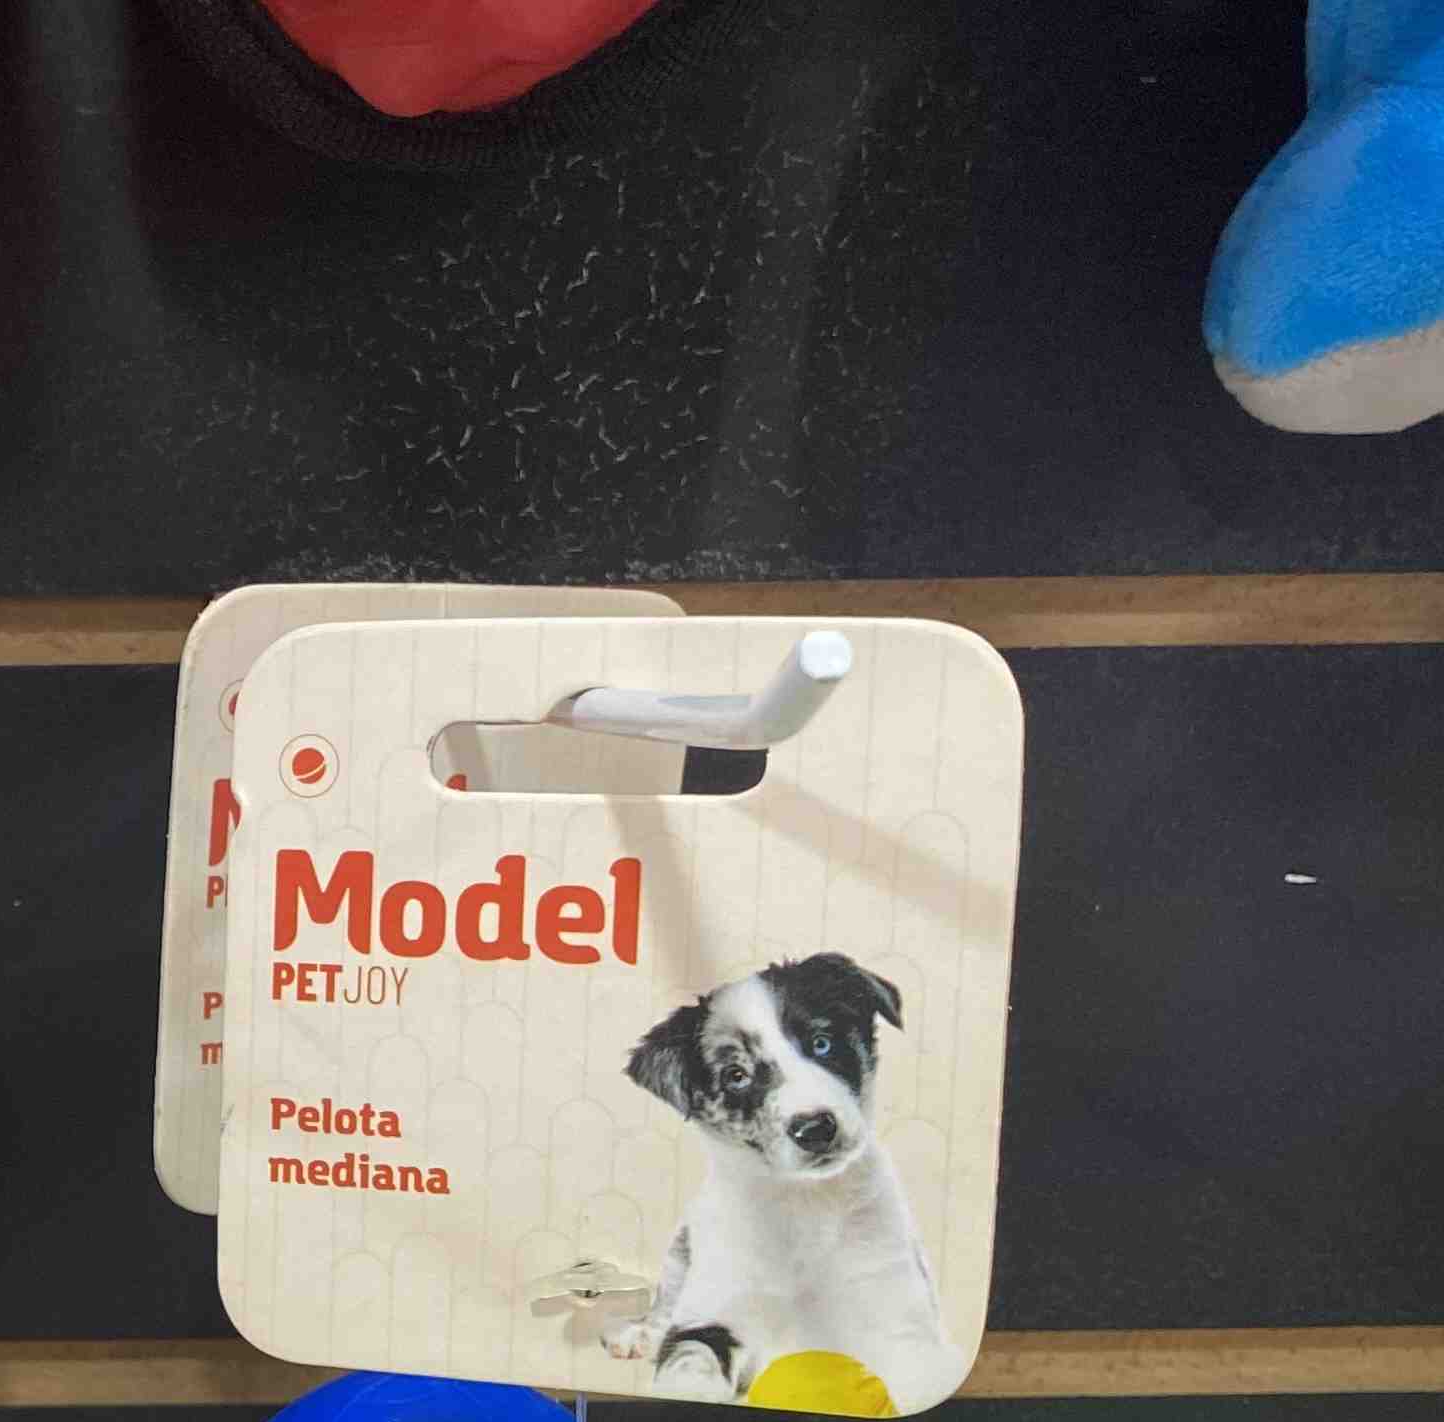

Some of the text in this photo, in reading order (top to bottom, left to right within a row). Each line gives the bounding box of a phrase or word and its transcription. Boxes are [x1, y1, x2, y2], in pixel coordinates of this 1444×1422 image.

[273, 849, 642, 965] Model
[271, 1097, 400, 1137] Pelota
[270, 1152, 449, 1194] mediana
